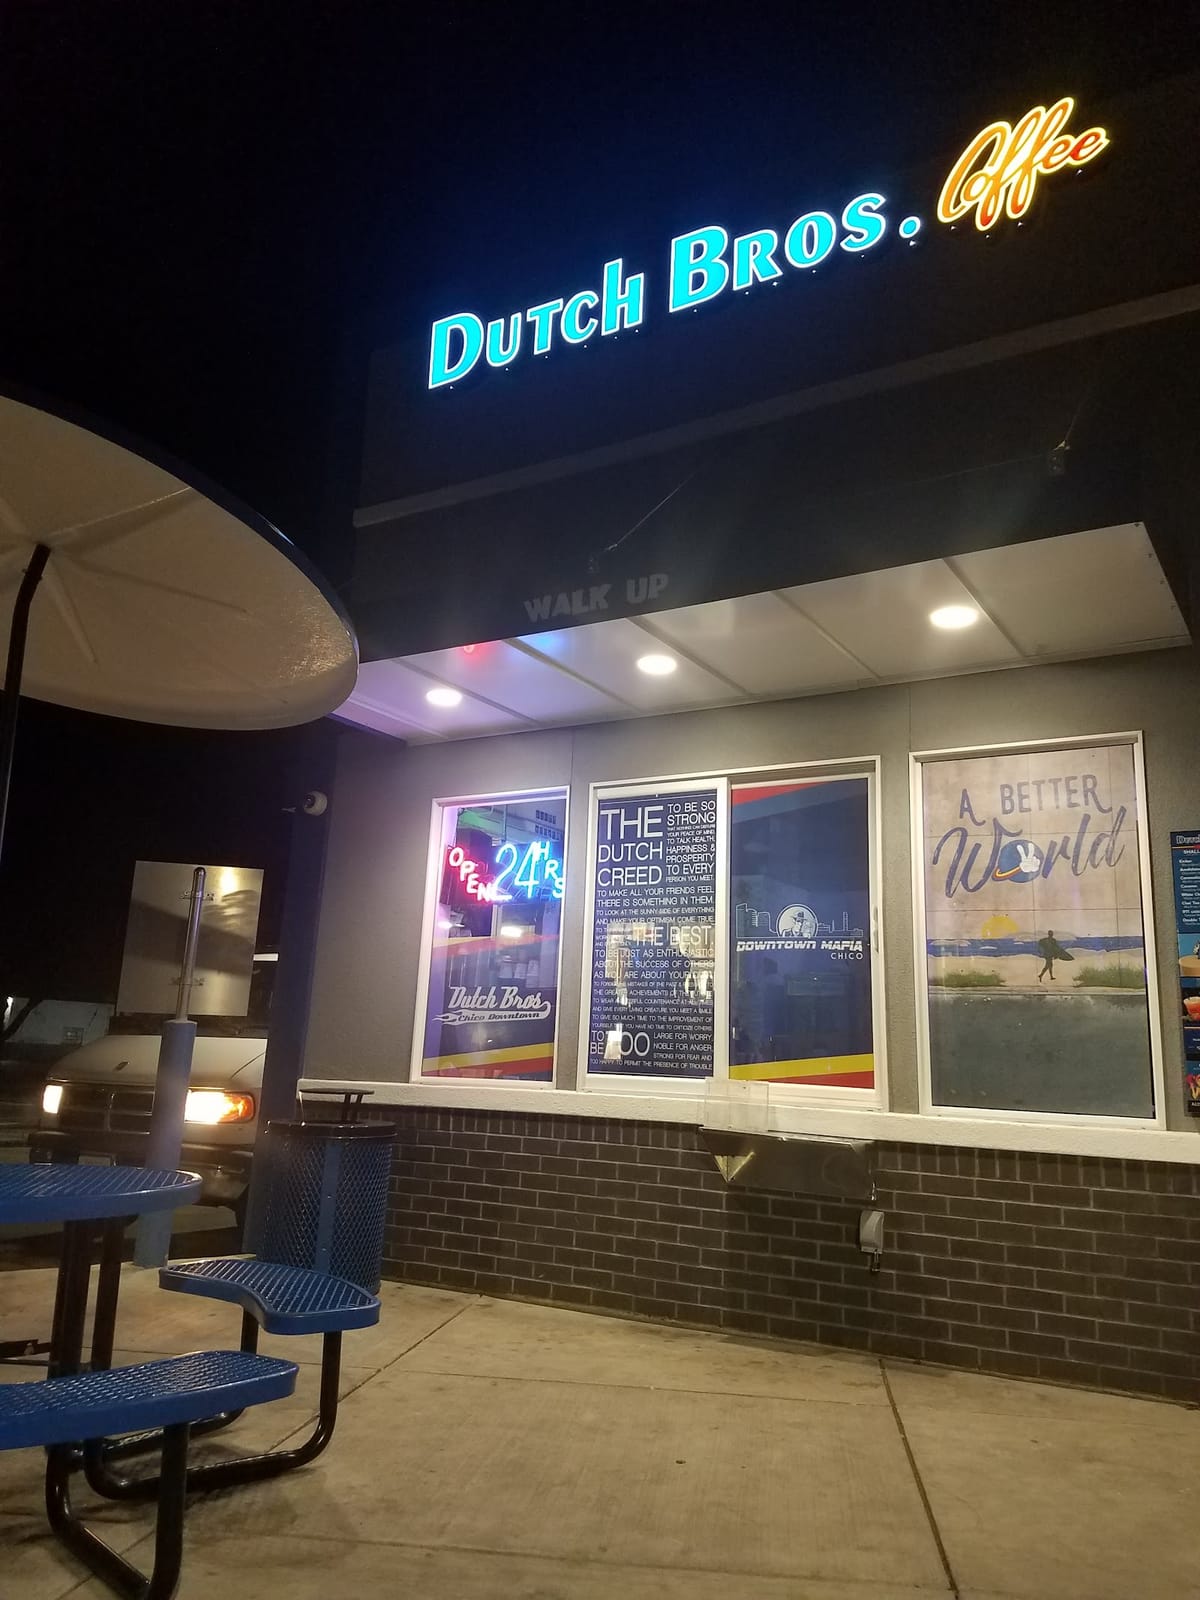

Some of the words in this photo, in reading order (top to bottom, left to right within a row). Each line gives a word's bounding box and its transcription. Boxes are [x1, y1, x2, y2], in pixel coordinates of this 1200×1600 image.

[937, 97, 1110, 231] Coffee
[429, 258, 644, 390] DUTCH
[523, 583, 612, 623] WALK
[625, 573, 669, 605] UP
[959, 788, 986, 826] A
[1000, 774, 1113, 815] BETTER
[667, 803, 682, 814] TO
[684, 802, 698, 812] BE
[701, 800, 716, 811] SO
[600, 805, 664, 840] THE
[667, 811, 716, 826] STRONG
[598, 841, 663, 863] DUTCH
[666, 844, 708, 855] HAPPINESS
[666, 853, 715, 864] PROSPERITY
[493, 841, 539, 900] 24
[666, 864, 680, 875] TO
[683, 862, 715, 875] EVERY
[597, 865, 662, 887] CREED
[597, 889, 607, 898] TO
[608, 888, 628, 897] MAKE
[629, 888, 643, 896] ALL
[644, 887, 664, 896] YOUR
[665, 886, 695, 895] FRIENDS
[597, 899, 621, 908] THERE
[623, 898, 630, 907] IS
[632, 897, 678, 906] SOMETHING
[680, 896, 689, 905] IN
[634, 926, 664, 946] THE
[736, 941, 817, 952] DOWNTOWN
[820, 941, 863, 952] MAFIA
[594, 949, 606, 958] TO
[642, 949, 654, 958] AS
[830, 952, 863, 960] CHICO
[635, 960, 669, 968] SUCCESS
[672, 960, 682, 968] OF
[593, 971, 604, 979] AS
[624, 971, 638, 979] ARE
[641, 971, 666, 979] ABOUT
[448, 986, 498, 1009] Dutch
[499, 986, 543, 1009] Bros
[458, 1013, 486, 1021] Chico
[488, 1012, 540, 1020] Downtown
[653, 1031, 673, 1040] LARGE
[674, 1032, 688, 1040] FOR
[590, 1042, 604, 1055] BE
[591, 1030, 605, 1042] TO
[605, 1030, 650, 1057] OO
[653, 1042, 674, 1050] NOBLE
[675, 1042, 689, 1050] FOR
